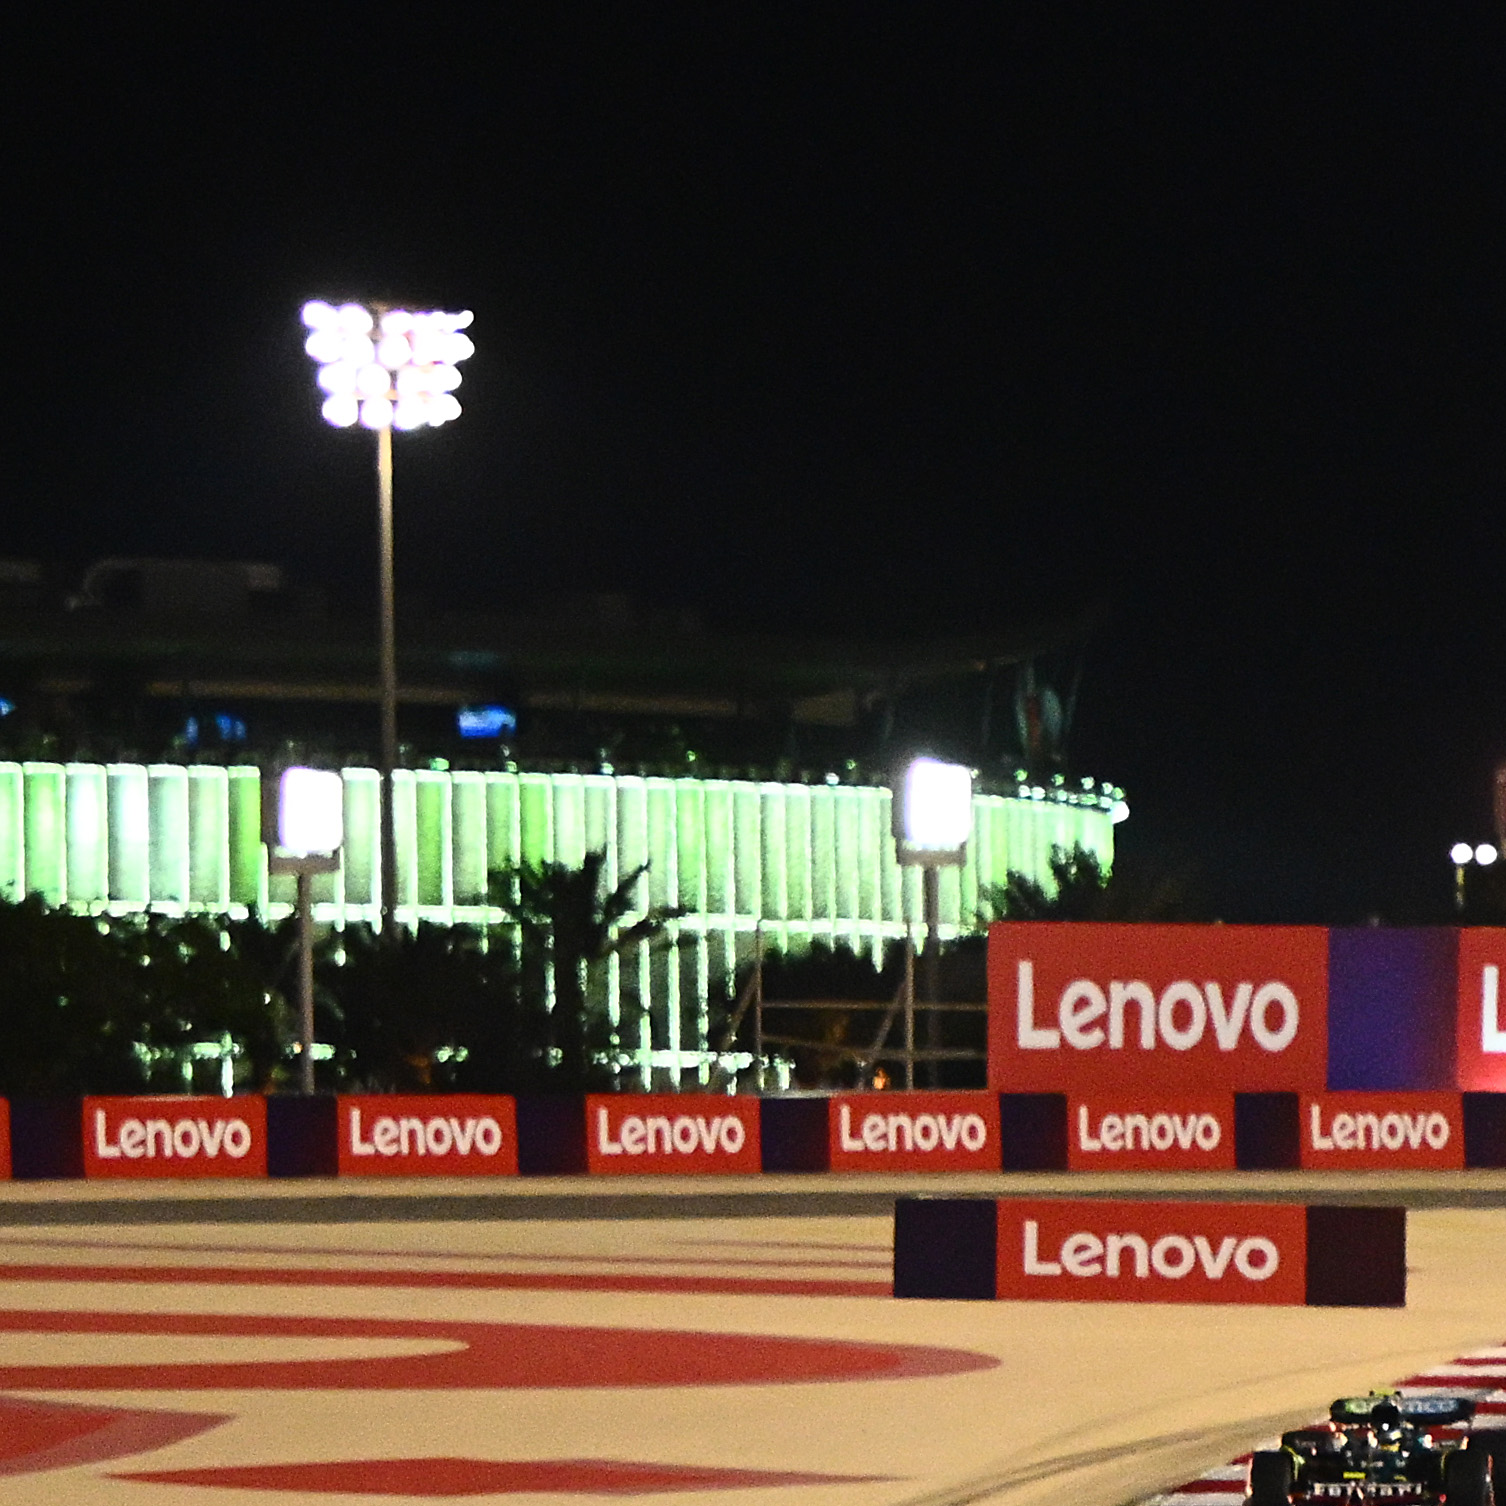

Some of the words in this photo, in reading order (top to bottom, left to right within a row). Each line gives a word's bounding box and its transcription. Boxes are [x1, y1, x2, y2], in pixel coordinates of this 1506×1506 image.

[1018, 961, 1298, 1051] Lenovo
[97, 1111, 250, 1157] Lenovo
[352, 1109, 501, 1155] Lenovo
[599, 1109, 744, 1154] Lenovo
[841, 1106, 986, 1151] Lenovo
[1080, 1106, 1220, 1151] Lenovo
[1311, 1105, 1449, 1149] Lenovo
[1025, 1221, 1278, 1279] Lenovo
